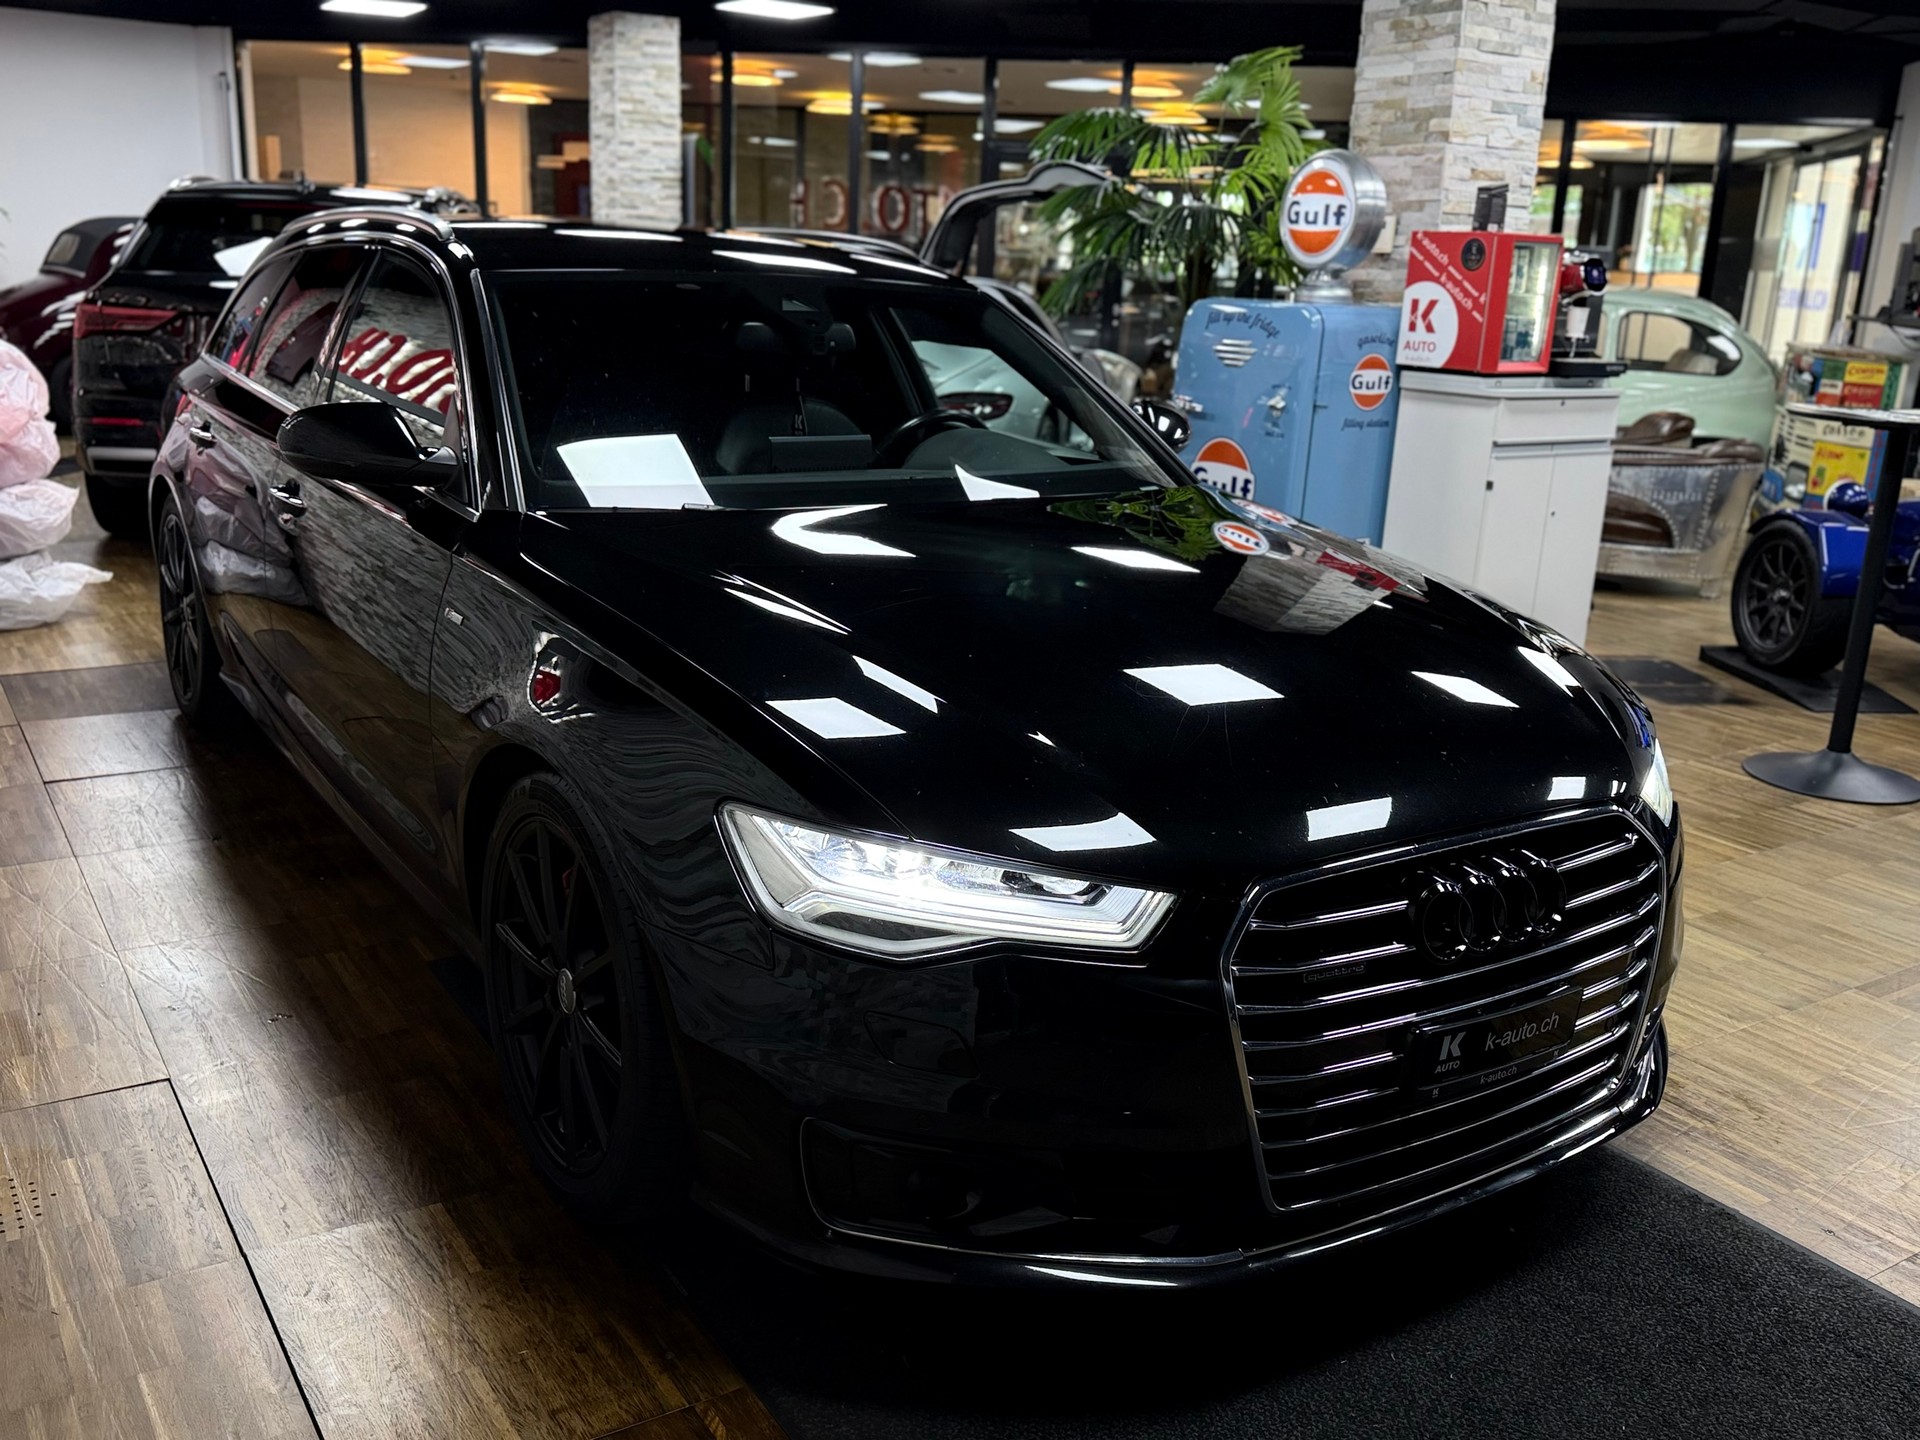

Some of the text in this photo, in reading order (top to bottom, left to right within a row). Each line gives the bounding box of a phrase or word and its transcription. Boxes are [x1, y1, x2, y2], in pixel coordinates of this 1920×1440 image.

[1287, 201, 1347, 226] Gulf
[1408, 298, 1440, 334] K
[1403, 340, 1437, 353] AUTO
[1351, 374, 1391, 390] Gulf
[1439, 1011, 1560, 1061] K k-auto.ch
[1434, 1060, 1461, 1074] AUTO
[1479, 1066, 1518, 1085] k-auto.ch
